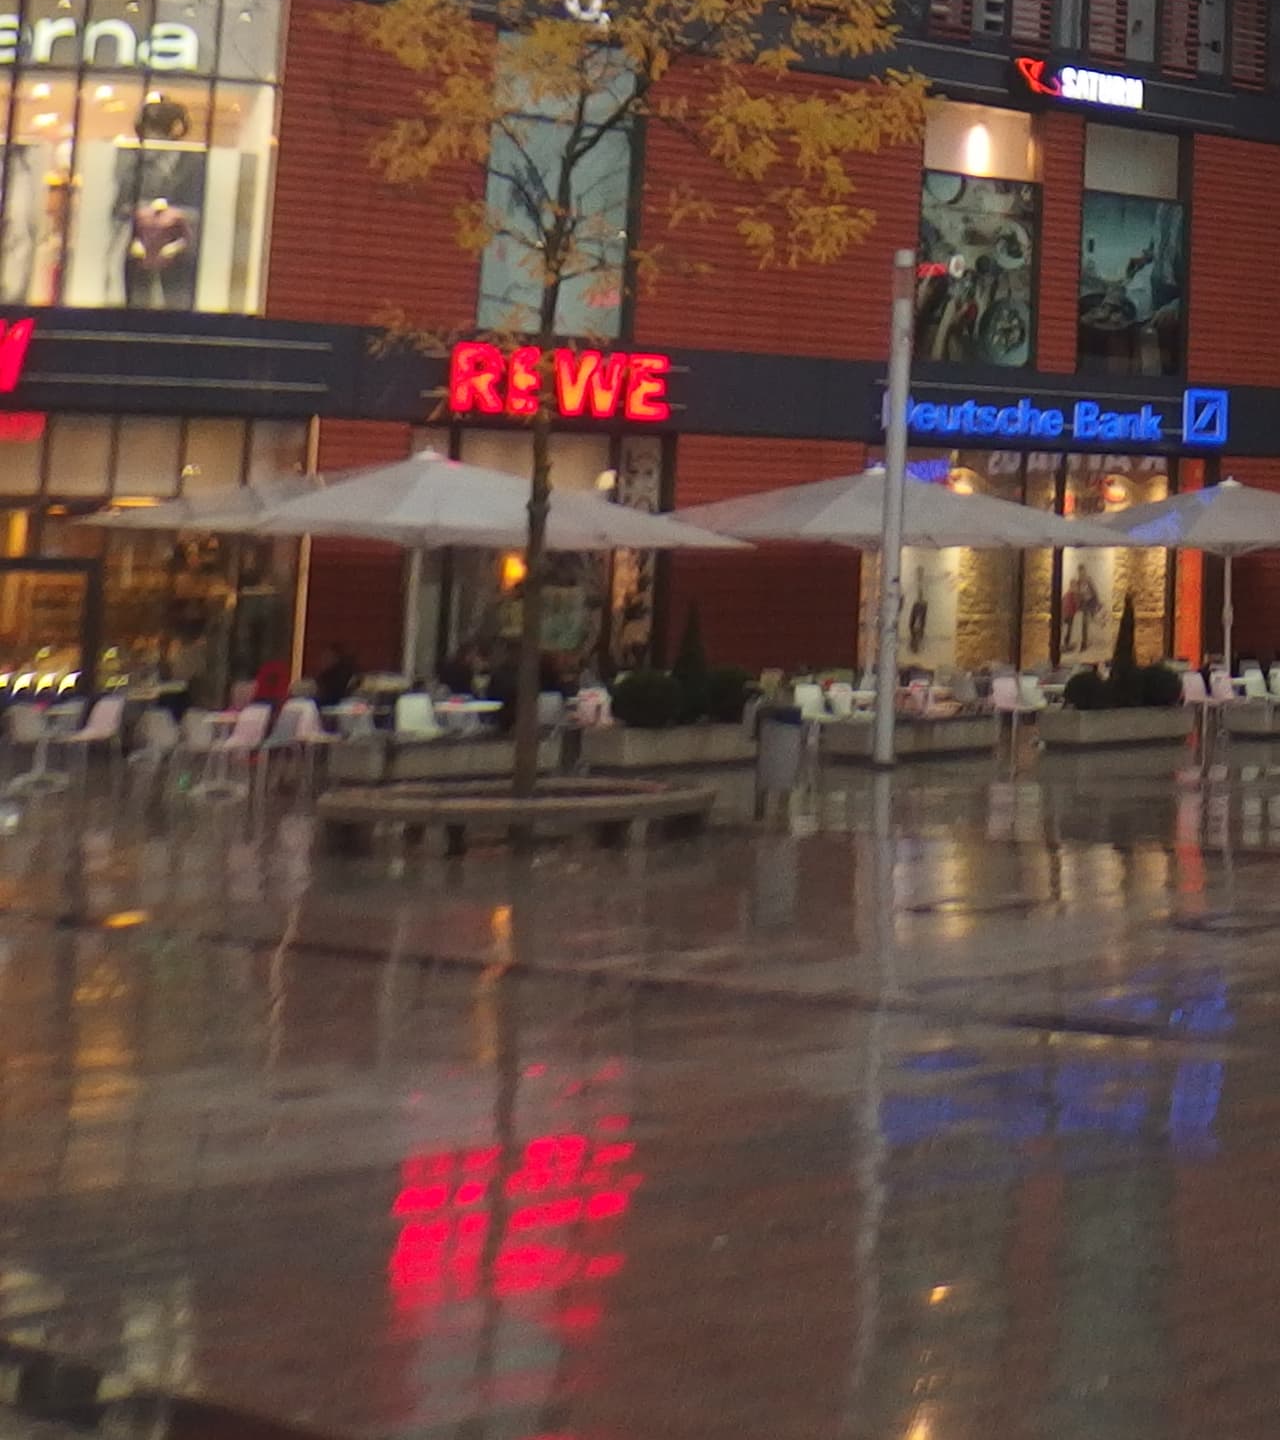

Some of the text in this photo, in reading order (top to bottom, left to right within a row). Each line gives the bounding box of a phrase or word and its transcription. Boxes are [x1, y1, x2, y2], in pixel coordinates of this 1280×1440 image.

[1061, 66, 1144, 109] SATURN
[450, 341, 671, 422] REWE
[1073, 400, 1162, 441] Bank
